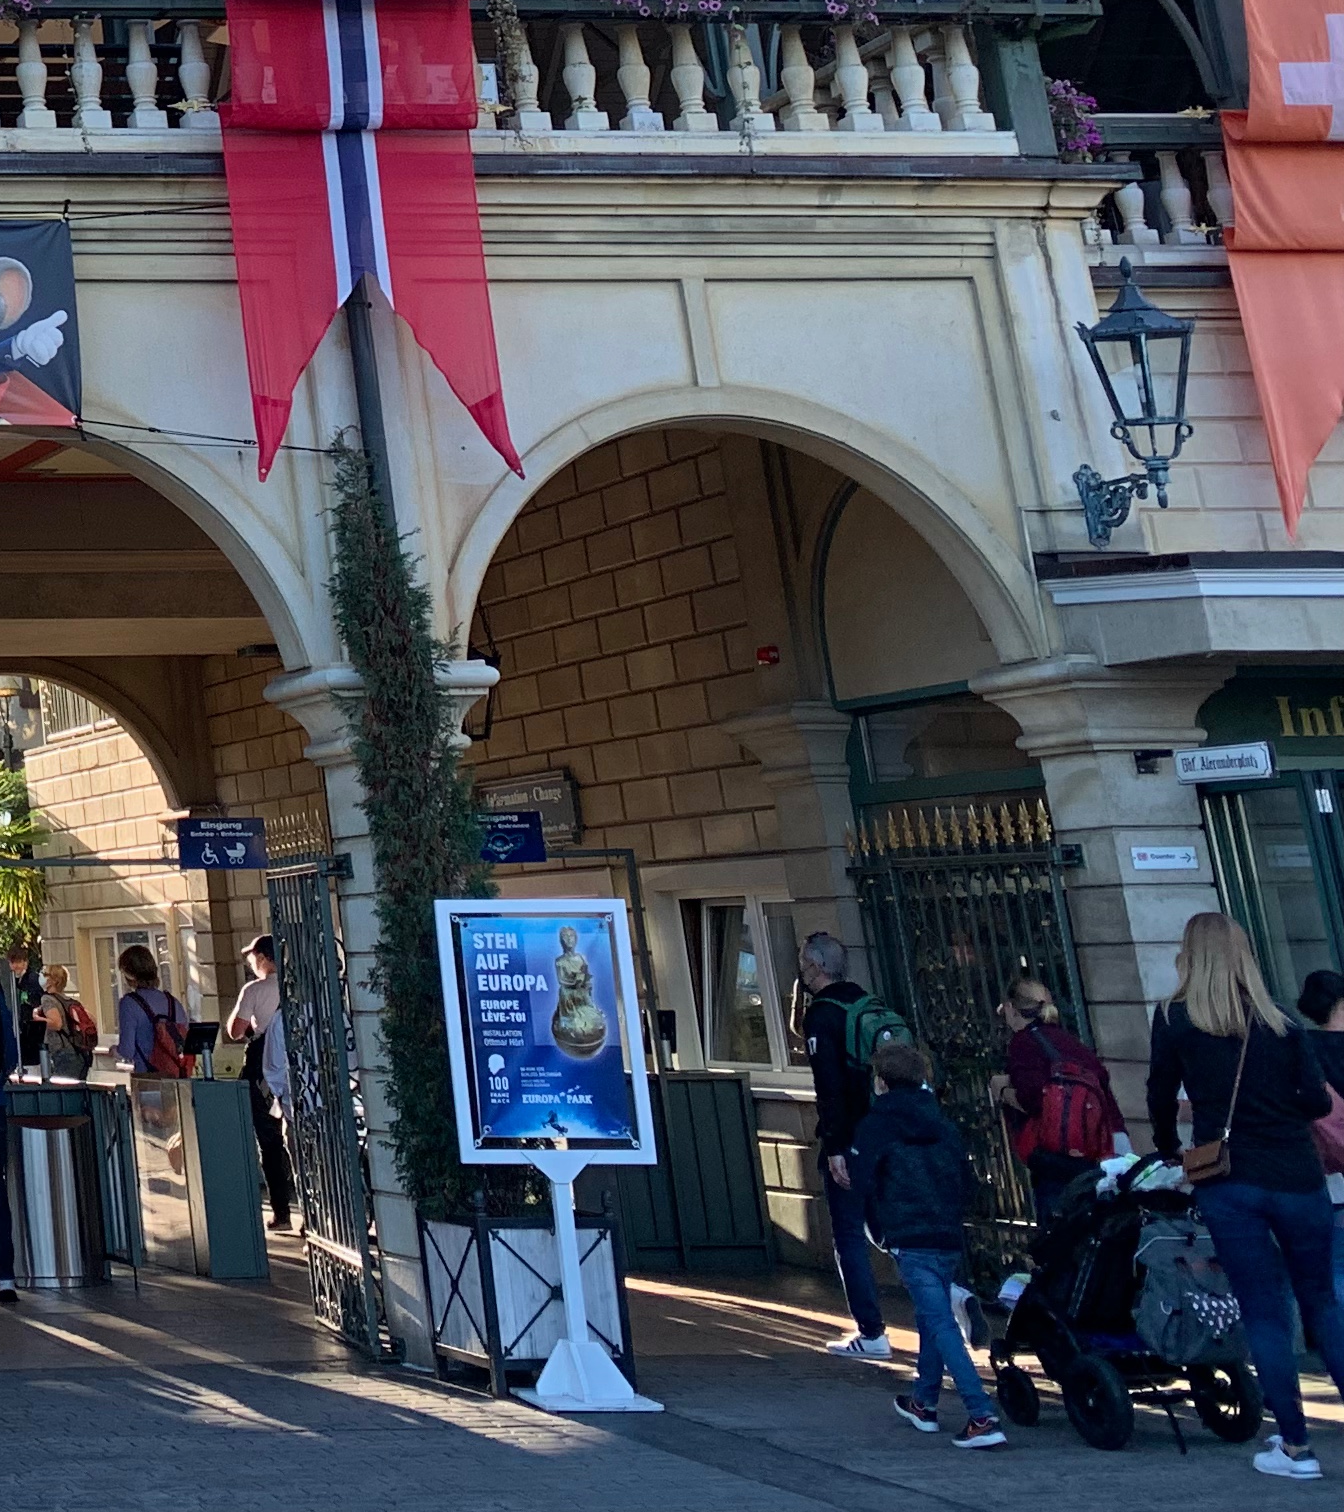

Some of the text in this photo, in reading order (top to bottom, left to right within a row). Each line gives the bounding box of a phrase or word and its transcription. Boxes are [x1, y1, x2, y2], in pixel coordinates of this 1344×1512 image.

[200, 821, 242, 831] Eingang
[472, 932, 518, 950] STEH
[475, 953, 510, 971] AUF
[477, 974, 549, 992] EUROPA
[480, 999, 520, 1011] EUROPE
[481, 1009, 527, 1023] LÈVE-TOI
[482, 1029, 523, 1038] INSTALLATION
[488, 1076, 510, 1091] 100
[522, 1093, 594, 1105] EUROPA PARK
